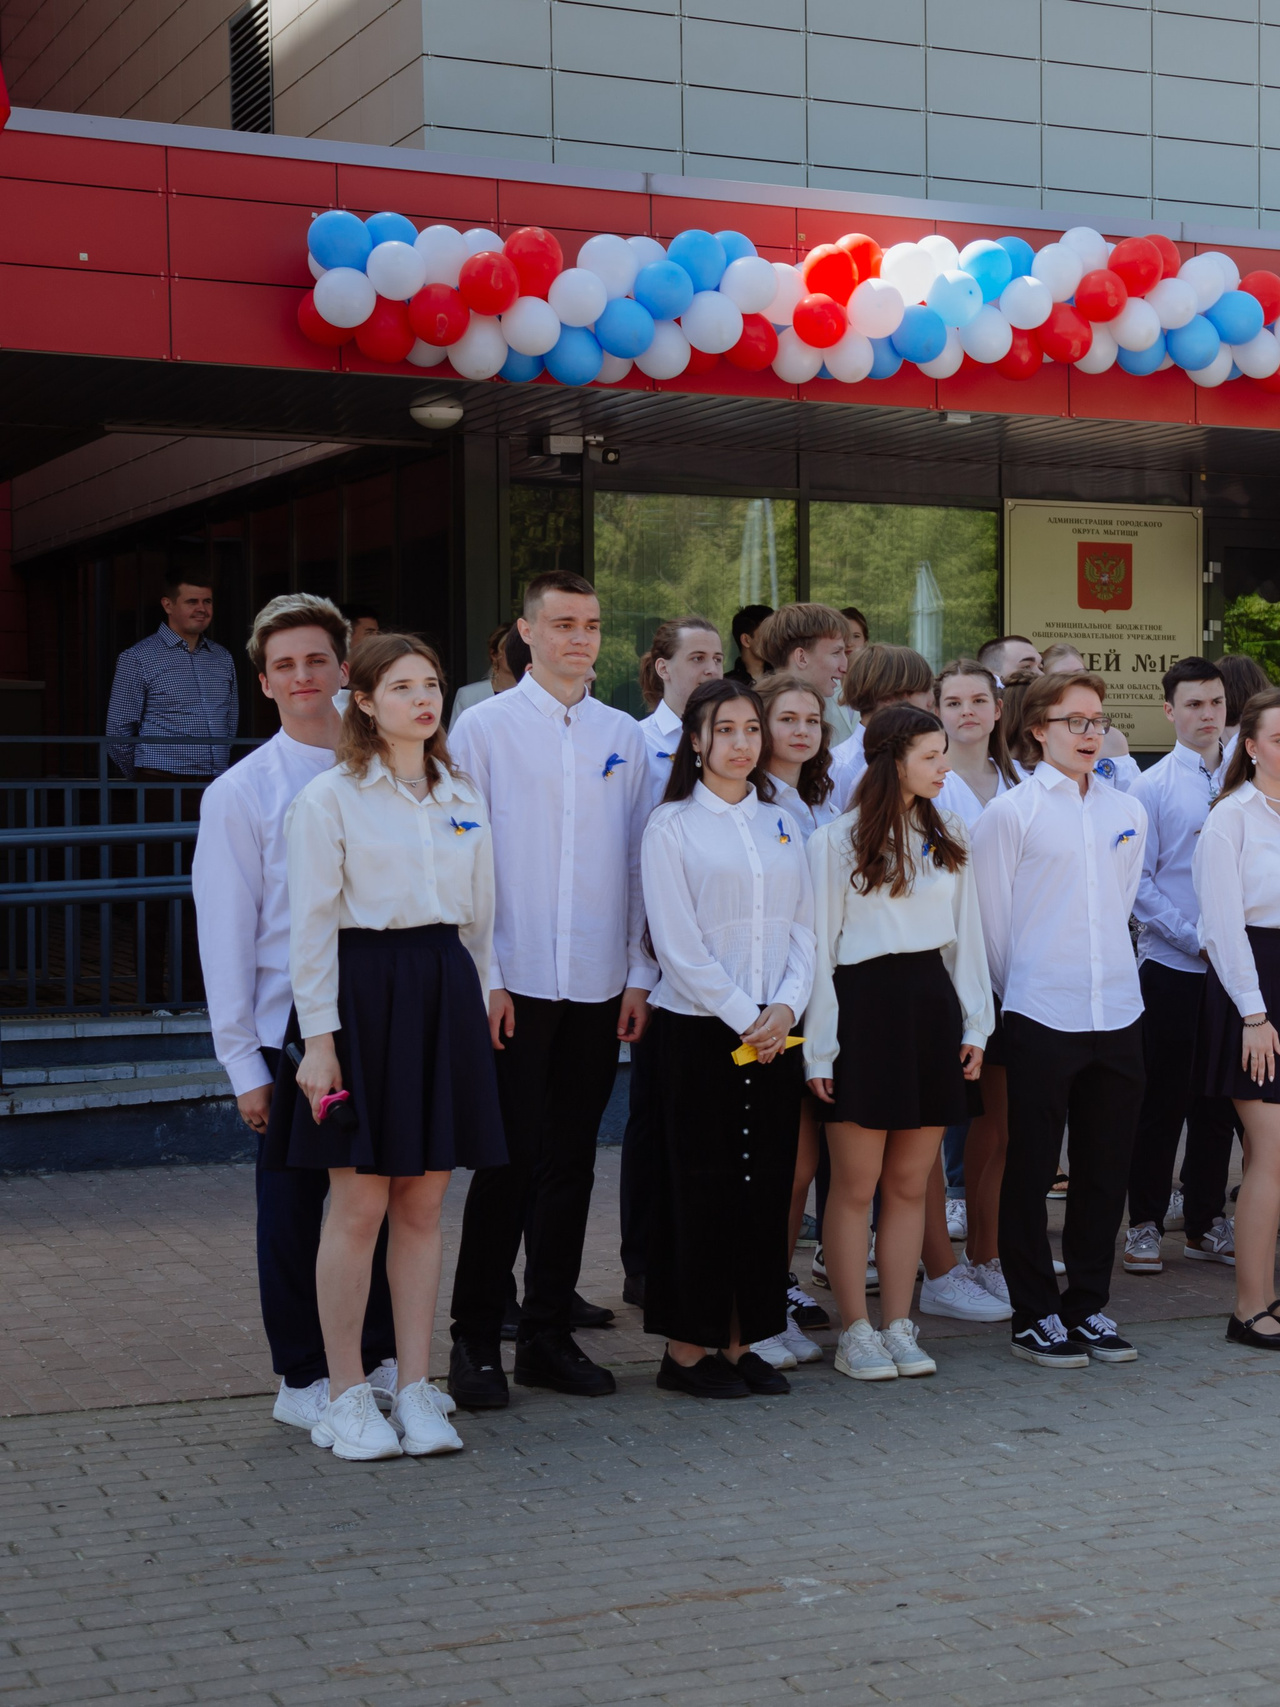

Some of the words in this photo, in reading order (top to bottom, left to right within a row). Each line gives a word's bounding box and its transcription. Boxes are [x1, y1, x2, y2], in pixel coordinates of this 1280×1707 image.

[1047, 517, 1113, 526] АДМИНИСТРАЦИЯ
[1116, 520, 1163, 528] ГОРОДСКОГО
[1045, 622, 1112, 630] МУНИЦИПАЛЬНОЕ
[1115, 623, 1163, 631] БЮДЖЕТНОЕ
[1032, 631, 1124, 640] ОБЩЕОБРАЗОВАТЕЛЬНОЕ
[1127, 633, 1177, 641] УЧРЕЖДЕНИЕ
